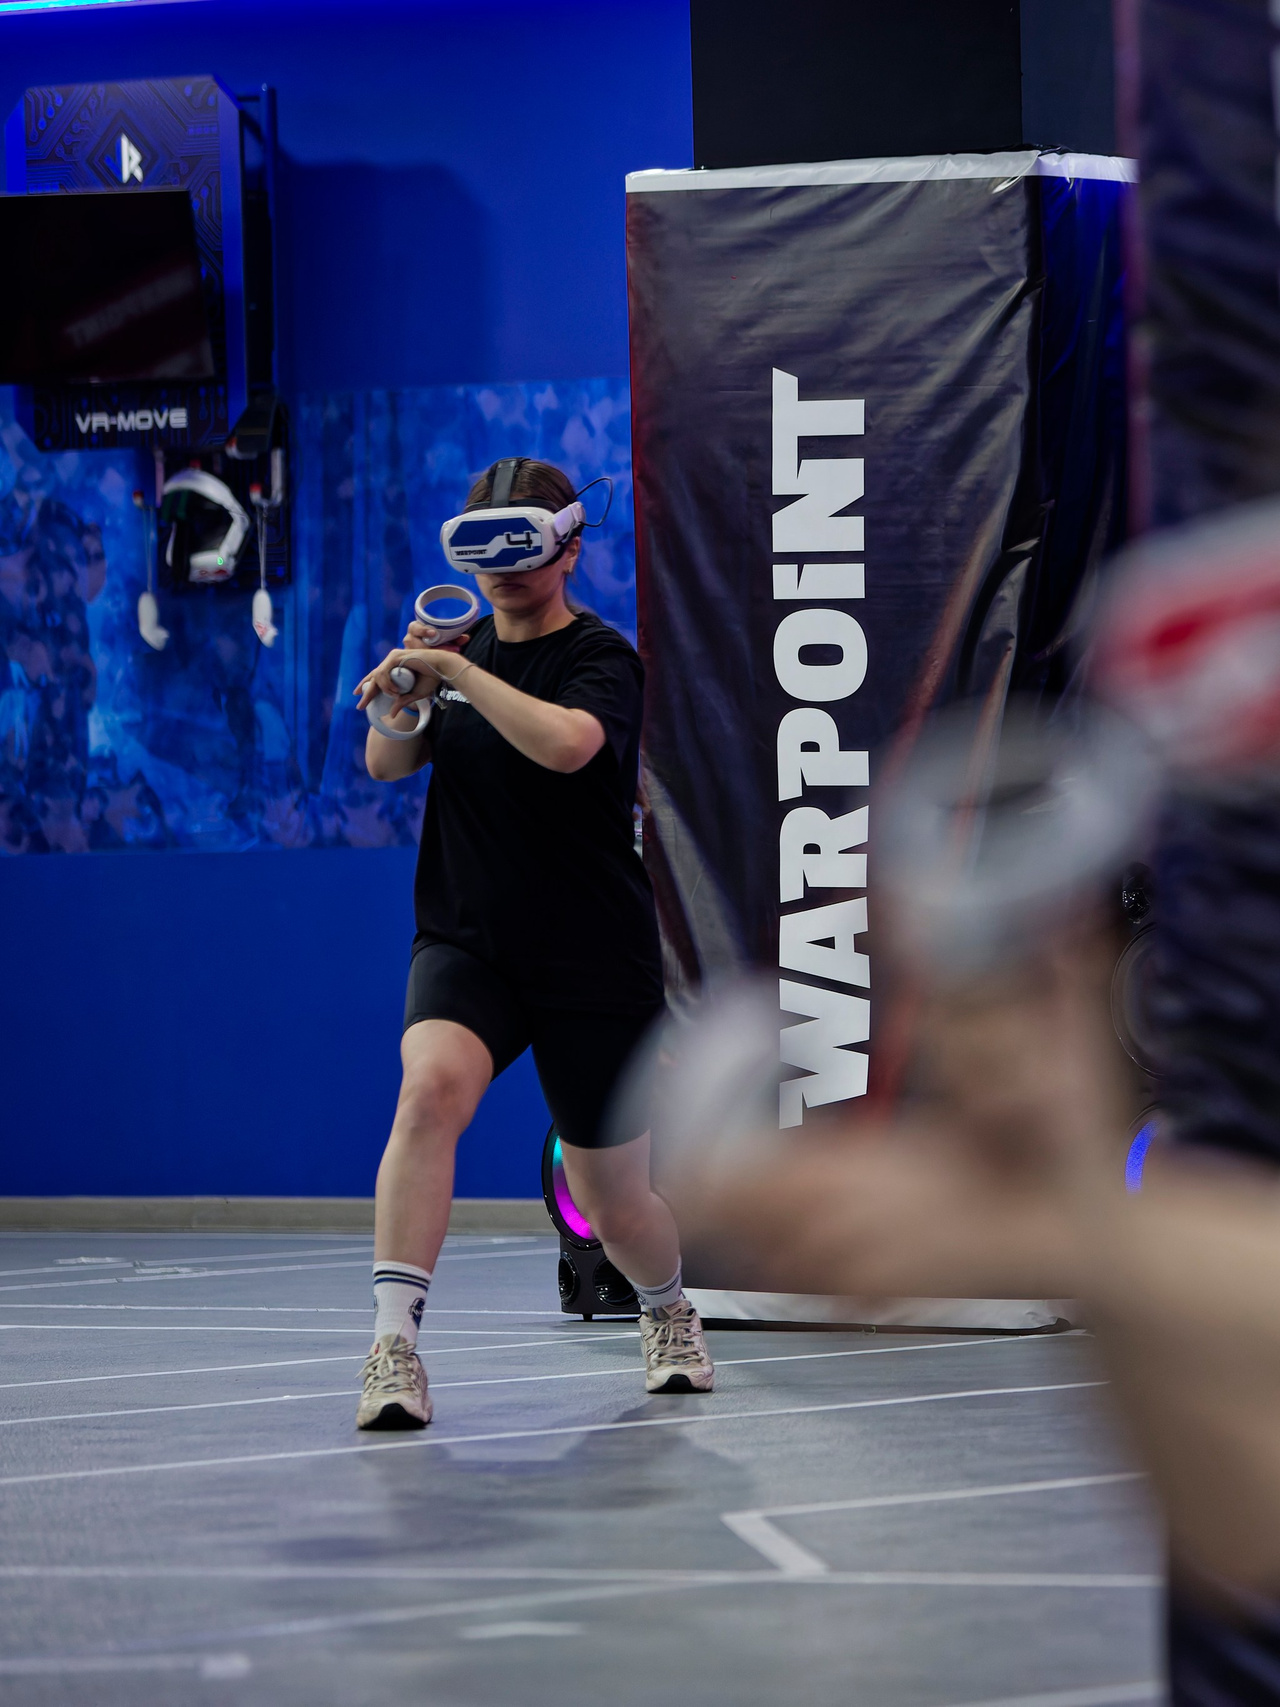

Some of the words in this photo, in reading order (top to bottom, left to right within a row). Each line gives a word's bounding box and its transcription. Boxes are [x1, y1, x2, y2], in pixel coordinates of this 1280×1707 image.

[75, 408, 188, 434] VR-MOVE
[504, 531, 533, 550] 4
[772, 367, 870, 1130] WARPOINT
